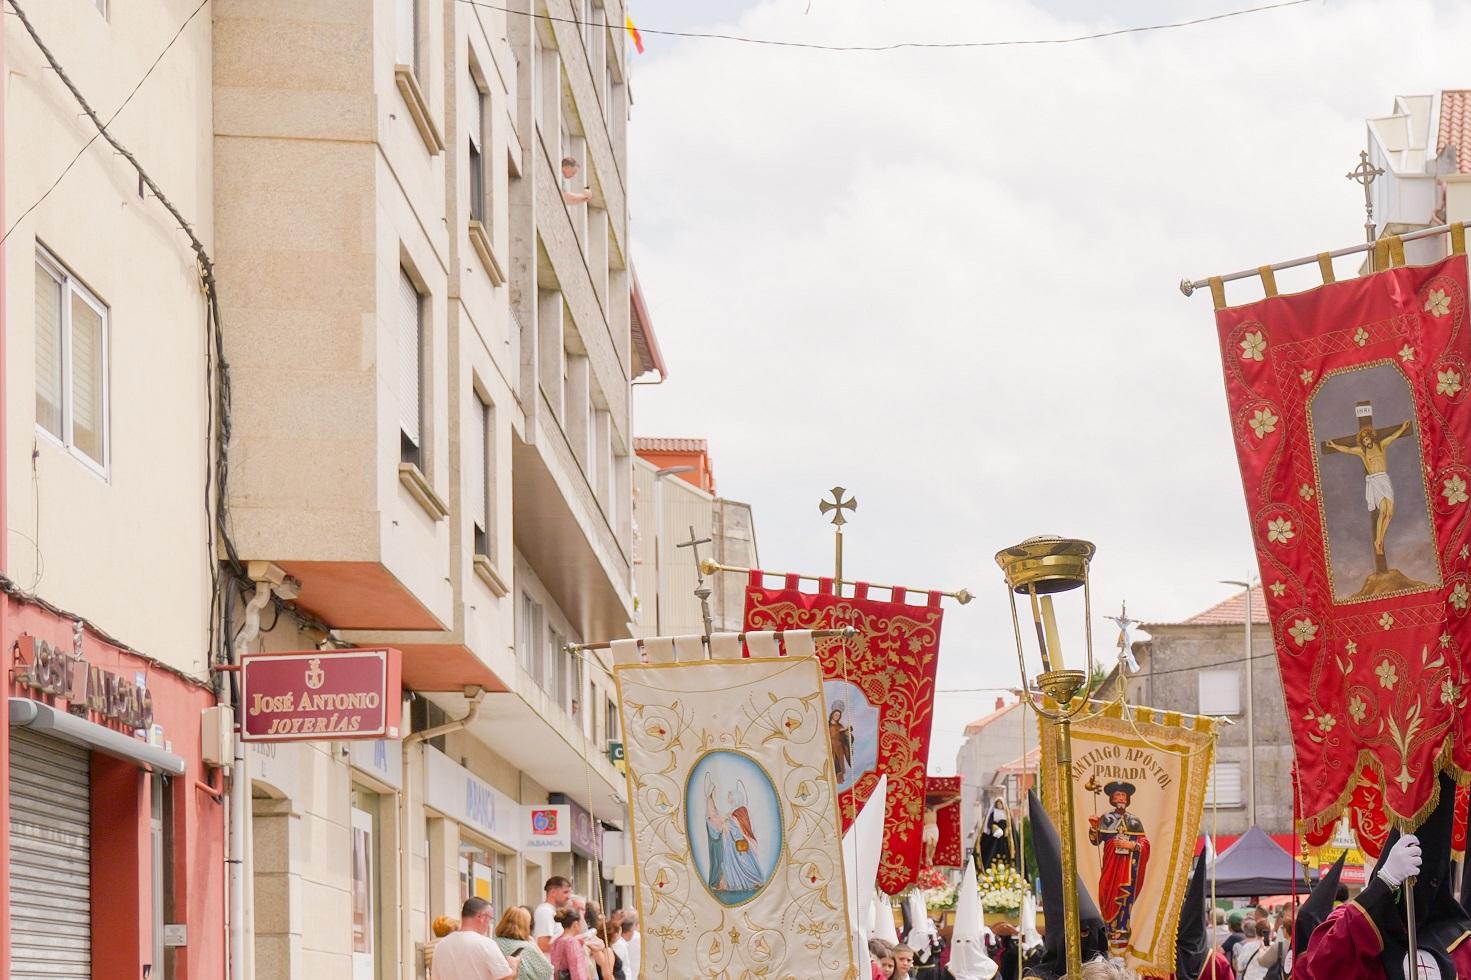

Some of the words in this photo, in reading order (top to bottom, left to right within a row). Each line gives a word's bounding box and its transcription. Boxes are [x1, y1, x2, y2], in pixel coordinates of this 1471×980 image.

[249, 691, 294, 716] JOSÉ
[297, 691, 380, 712] ANTONIO
[268, 713, 361, 734] JOYERÍAS
[1071, 745, 1120, 782] SANTIAGO
[1095, 764, 1147, 779] PARADA
